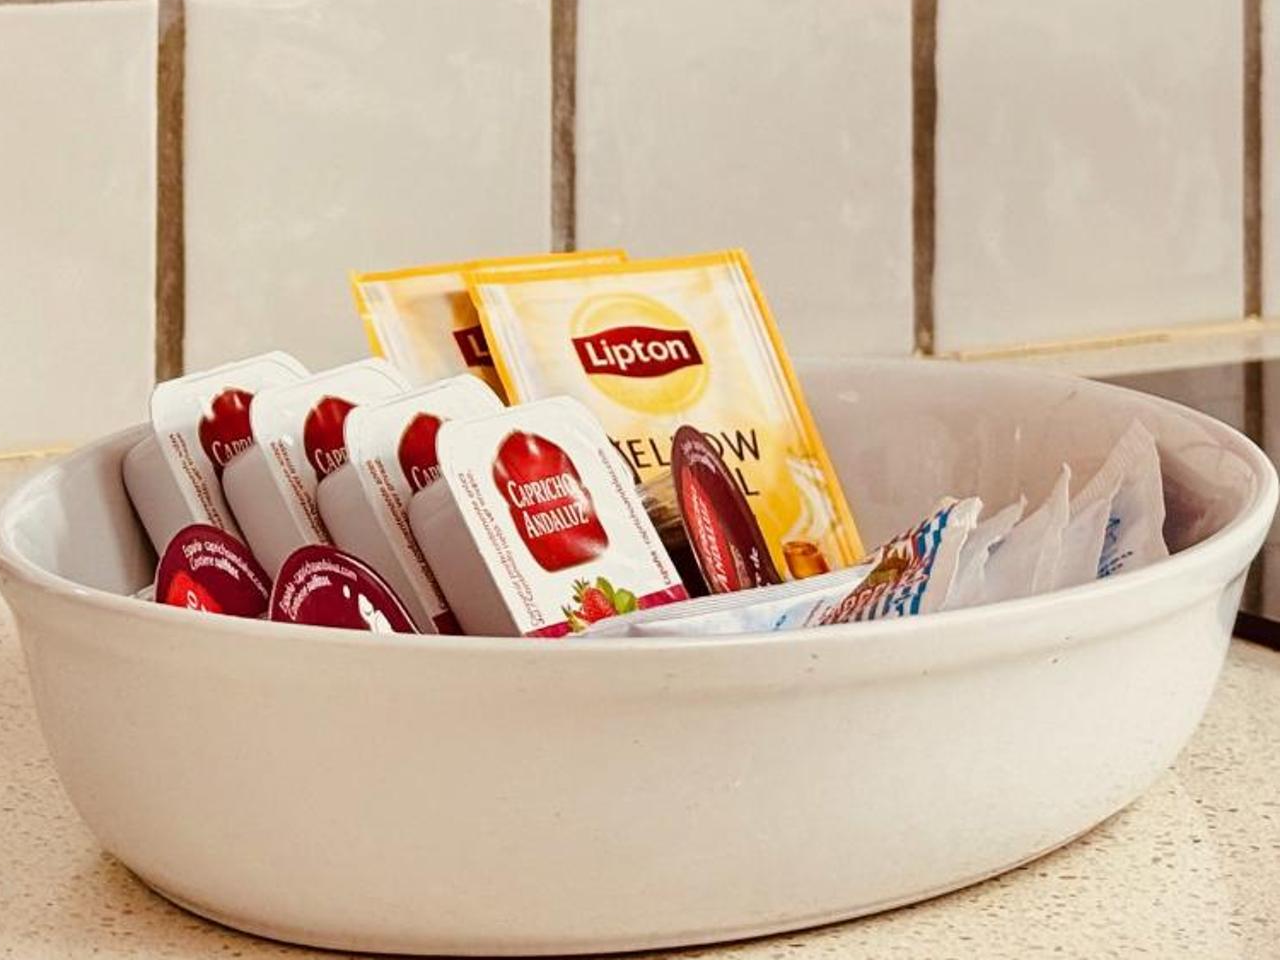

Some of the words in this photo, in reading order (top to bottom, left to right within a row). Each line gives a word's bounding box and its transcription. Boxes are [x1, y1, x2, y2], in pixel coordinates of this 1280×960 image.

[584, 338, 690, 371] Lipton
[506, 472, 579, 508] CAPRICHO
[522, 501, 590, 538] ANDALUZ
